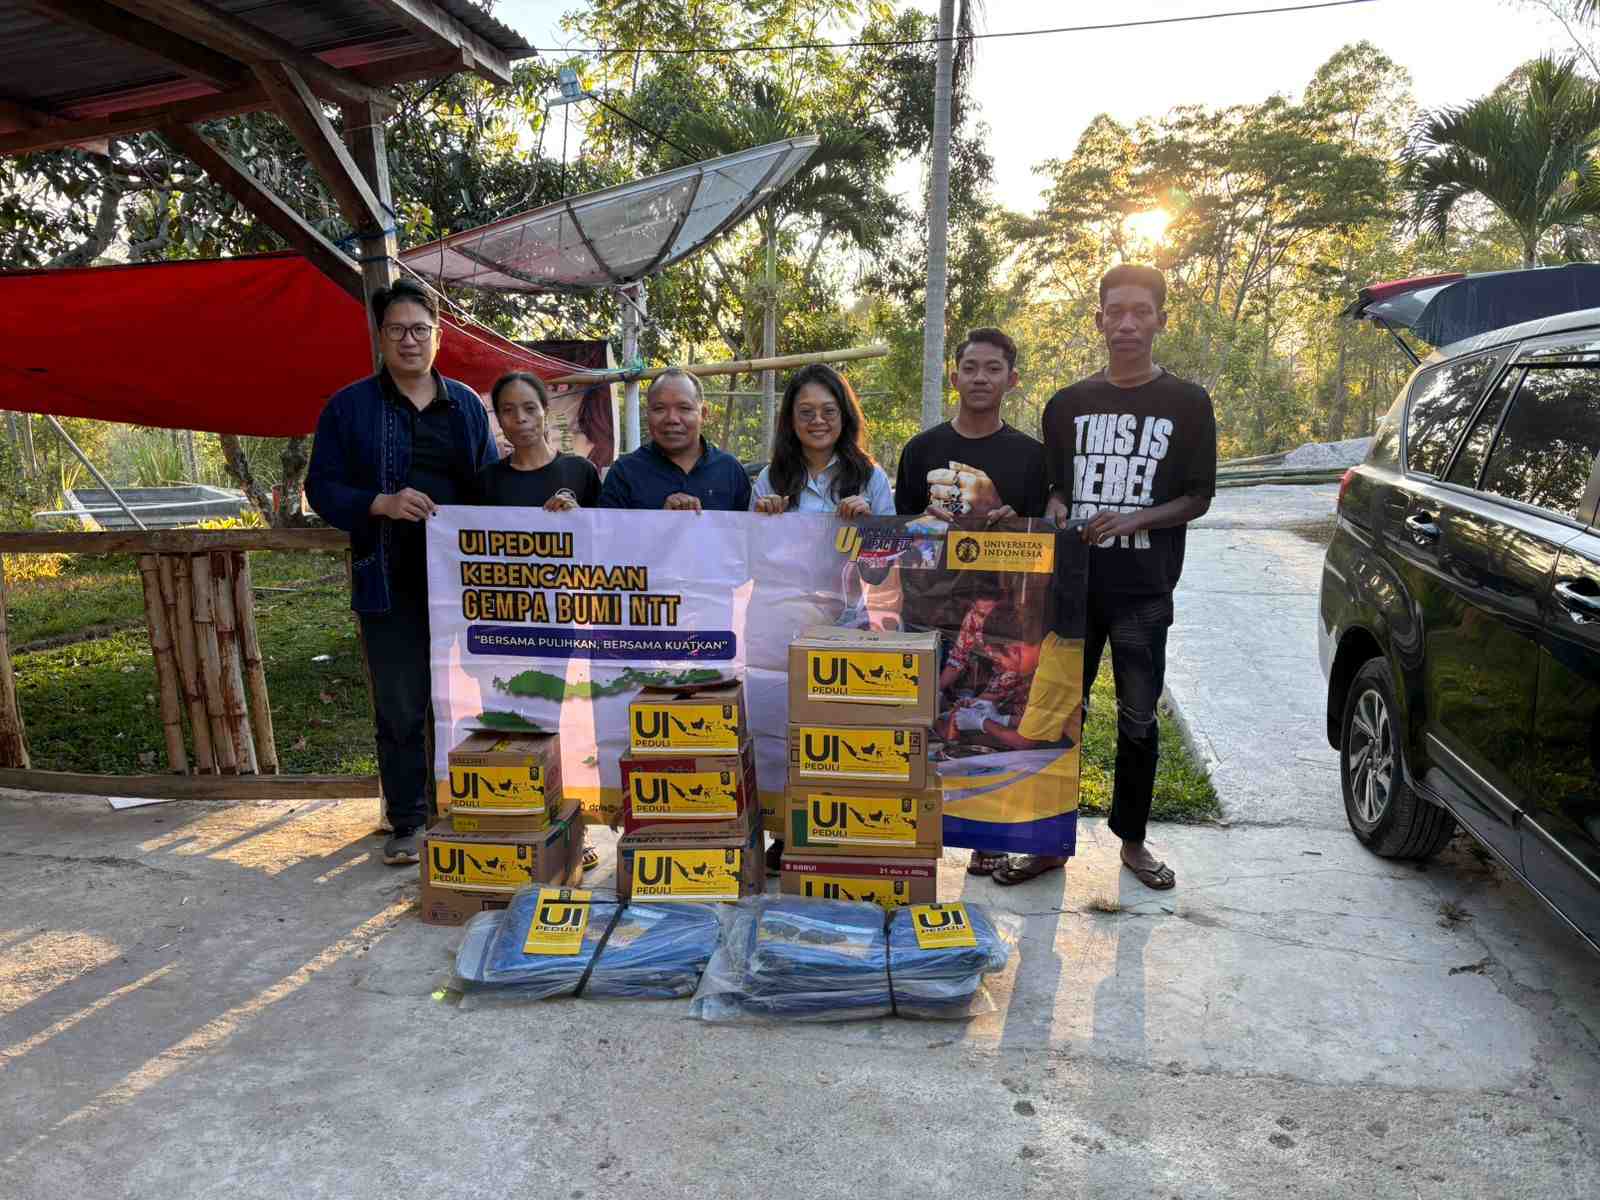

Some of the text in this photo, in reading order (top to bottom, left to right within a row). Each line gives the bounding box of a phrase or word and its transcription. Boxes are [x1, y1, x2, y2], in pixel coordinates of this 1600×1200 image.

[1074, 414, 1174, 460] THIS IS
[1072, 455, 1158, 506] REBEL
[459, 529, 574, 558] UI PEDULI
[983, 540, 1043, 549] UNIVERSITAS
[984, 549, 1043, 558] INDONESIA
[460, 561, 648, 591] KEBENCANAAN
[463, 589, 681, 626] GEMPA BUMI NTT
[474, 635, 728, 652] "BERSAMA PULIHKAN, BERSAMA KUATKAN"
[813, 656, 848, 685] UI
[812, 686, 848, 695] PEDULI
[635, 711, 669, 738] UI
[635, 739, 670, 748] PEDULI
[805, 734, 840, 762] UI
[804, 763, 840, 772] PEDULI
[450, 772, 479, 799] UI
[634, 778, 669, 804] UI
[636, 804, 671, 813] PEDULI
[812, 800, 848, 829] UI
[812, 829, 848, 838] PEDULI
[434, 847, 464, 875] UI
[638, 857, 672, 885] UI
[636, 886, 671, 895] PEDULI
[540, 907, 583, 926] UI
[918, 910, 964, 928] UI
